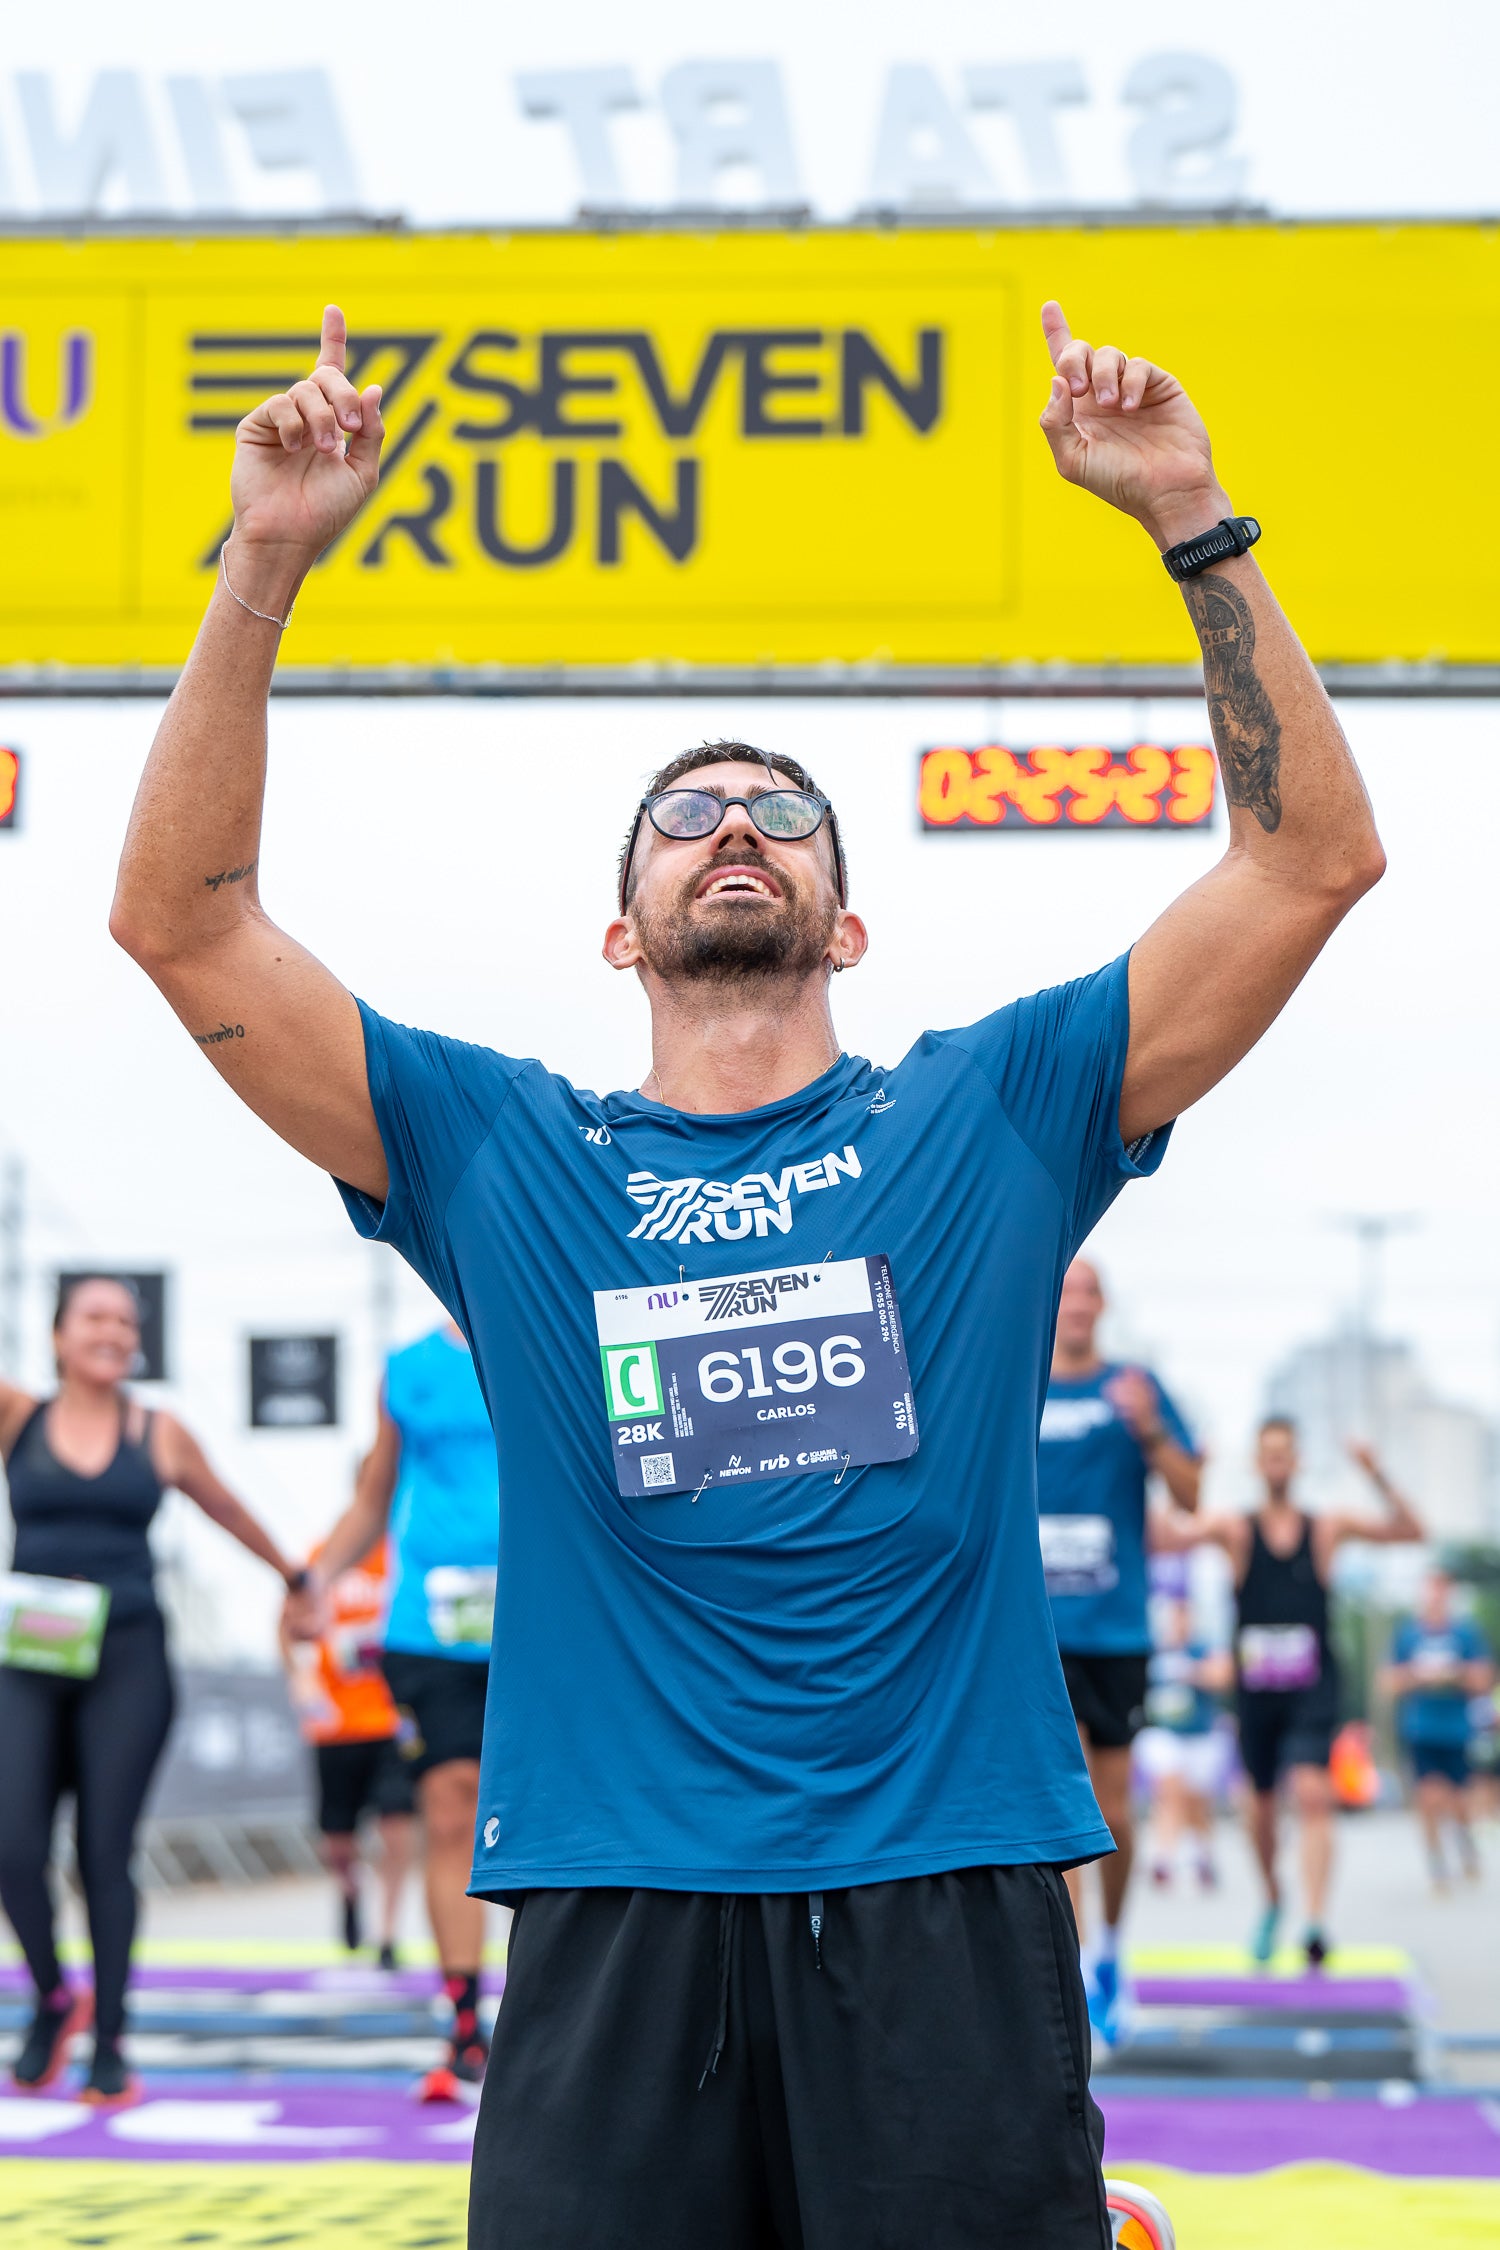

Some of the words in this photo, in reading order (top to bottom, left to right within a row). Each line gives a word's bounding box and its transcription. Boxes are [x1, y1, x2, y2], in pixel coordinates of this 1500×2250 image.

[448, 328, 944, 440] SEVEN
[357, 458, 702, 570] RUN
[702, 1145, 863, 1213] SEVEN
[678, 1199, 794, 1245] RUN
[736, 1272, 810, 1297] SEVEN
[874, 1280, 882, 1291] 11
[880, 1264, 892, 1300] TELEFONE
[727, 1294, 778, 1318] RUN
[876, 1292, 885, 1308] 955
[886, 1300, 894, 1311] DE
[879, 1309, 888, 1326] 006
[881, 1326, 891, 1343] 296
[888, 1310, 900, 1355] EMERGÊNCIA
[698, 1335, 866, 1402] 6196
[619, 1355, 646, 1407] C
[756, 1403, 817, 1421] CARLOS
[893, 1401, 908, 1430] 6196
[617, 1422, 665, 1445] 28K
[760, 1454, 791, 1471] rvb
[809, 1448, 838, 1458] IGUANA
[810, 1454, 838, 1463] SPORTS
[719, 1466, 752, 1478] NEWON
